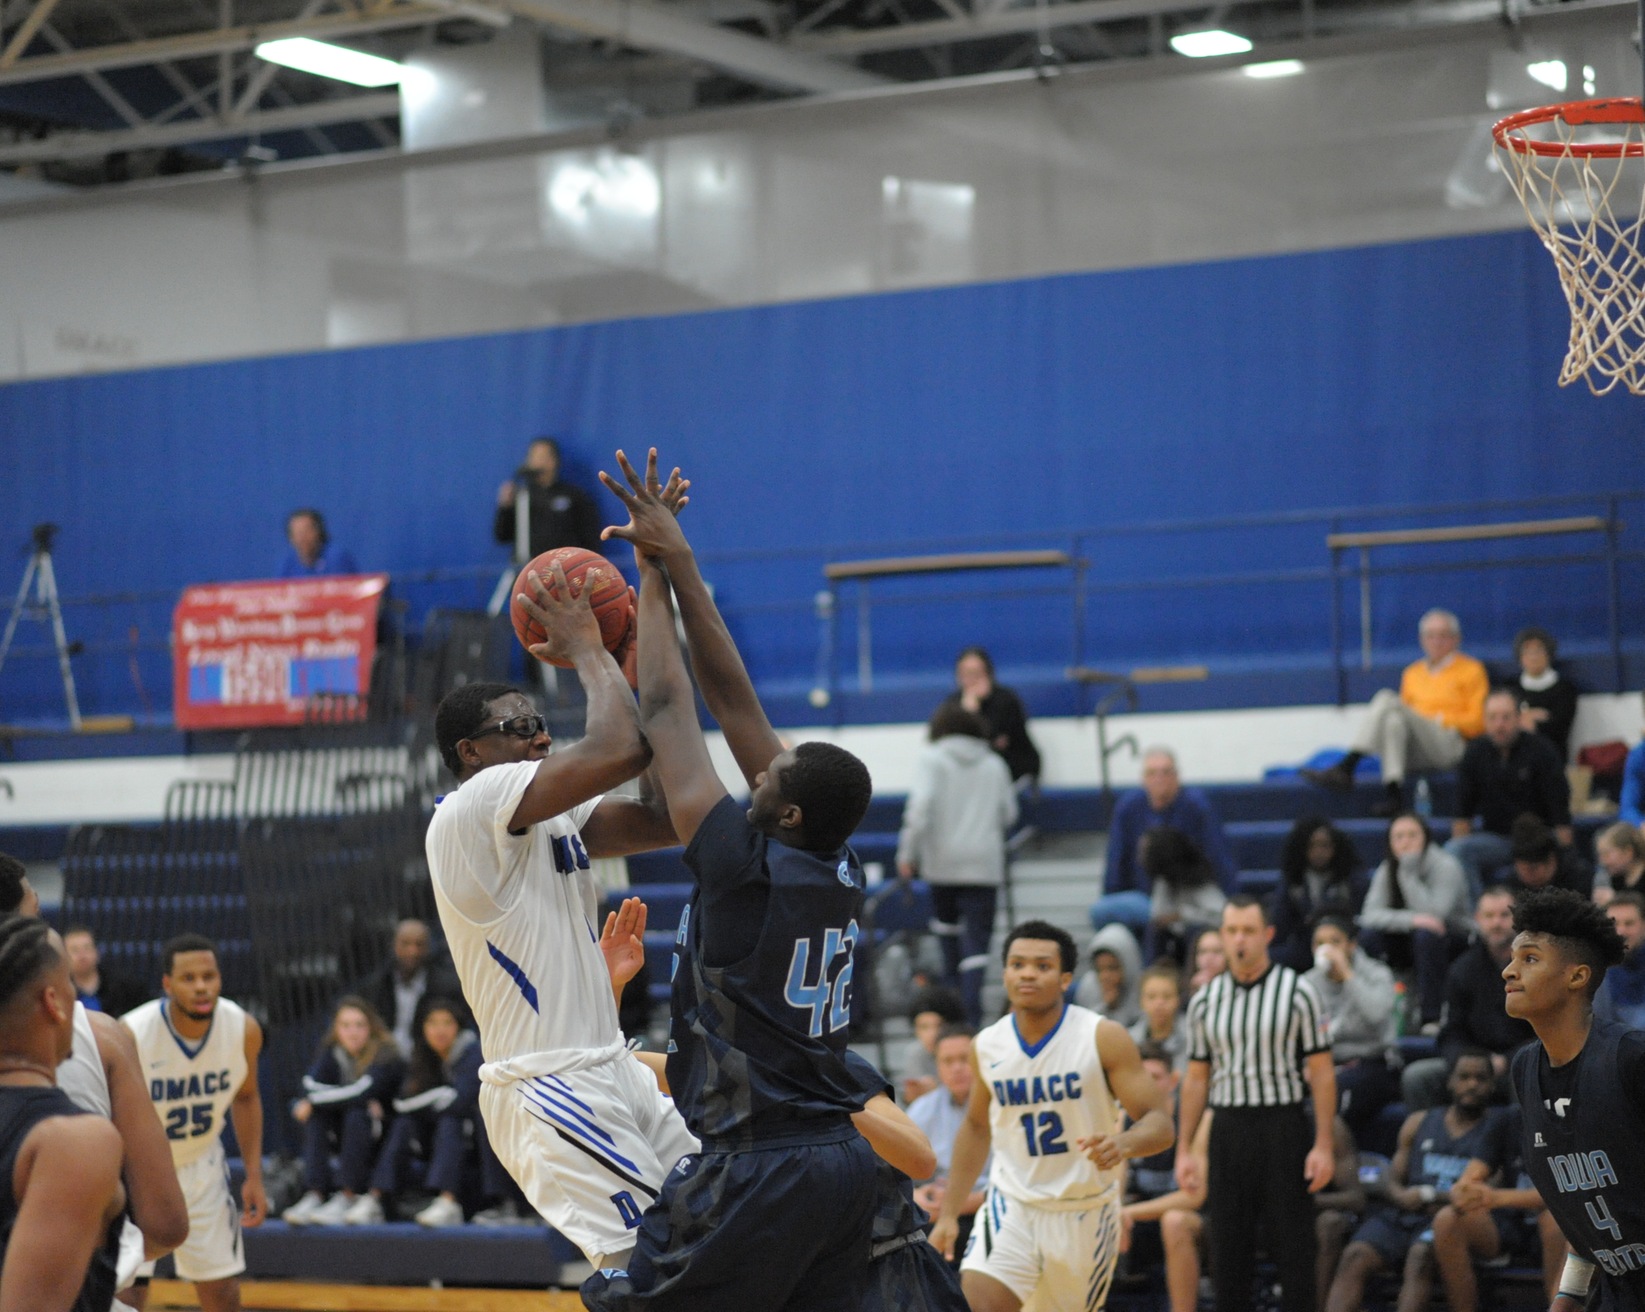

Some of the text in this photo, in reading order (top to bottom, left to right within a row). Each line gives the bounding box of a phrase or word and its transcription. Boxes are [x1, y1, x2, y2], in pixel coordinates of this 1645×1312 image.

[993, 1072, 1082, 1107] DMACC
[165, 1102, 214, 1140] 25
[1020, 1110, 1069, 1156] 12
[1547, 1149, 1619, 1193] IOWA
[609, 1190, 643, 1230] D
[1584, 1194, 1623, 1240] 4
